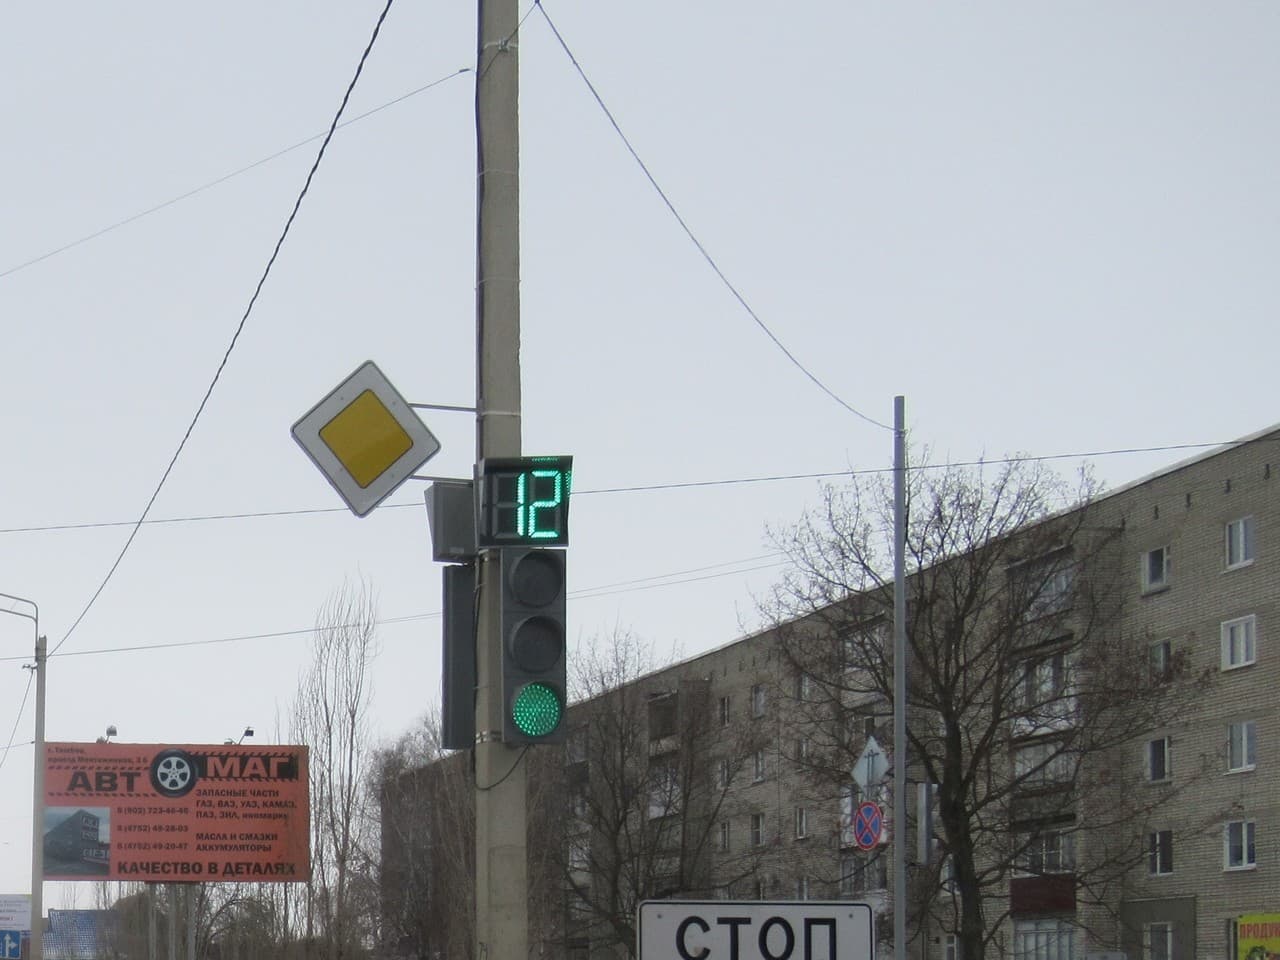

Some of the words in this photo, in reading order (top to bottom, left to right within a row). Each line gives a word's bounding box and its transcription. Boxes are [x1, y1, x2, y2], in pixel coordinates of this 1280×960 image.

[516, 470, 562, 539] 12
[195, 789, 248, 798] ЗАПАСНЫЕ
[249, 789, 279, 798] ЧАСТИ
[195, 833, 227, 841] МАСЛА
[230, 833, 236, 841] И
[239, 833, 278, 841] СМАЗКИ
[195, 844, 272, 852] АККУМУЛЯТОРЫ
[117, 862, 203, 875] КАЧЕСТВО
[208, 862, 218, 875] В
[222, 862, 296, 877] ДЕТАЛЯХ
